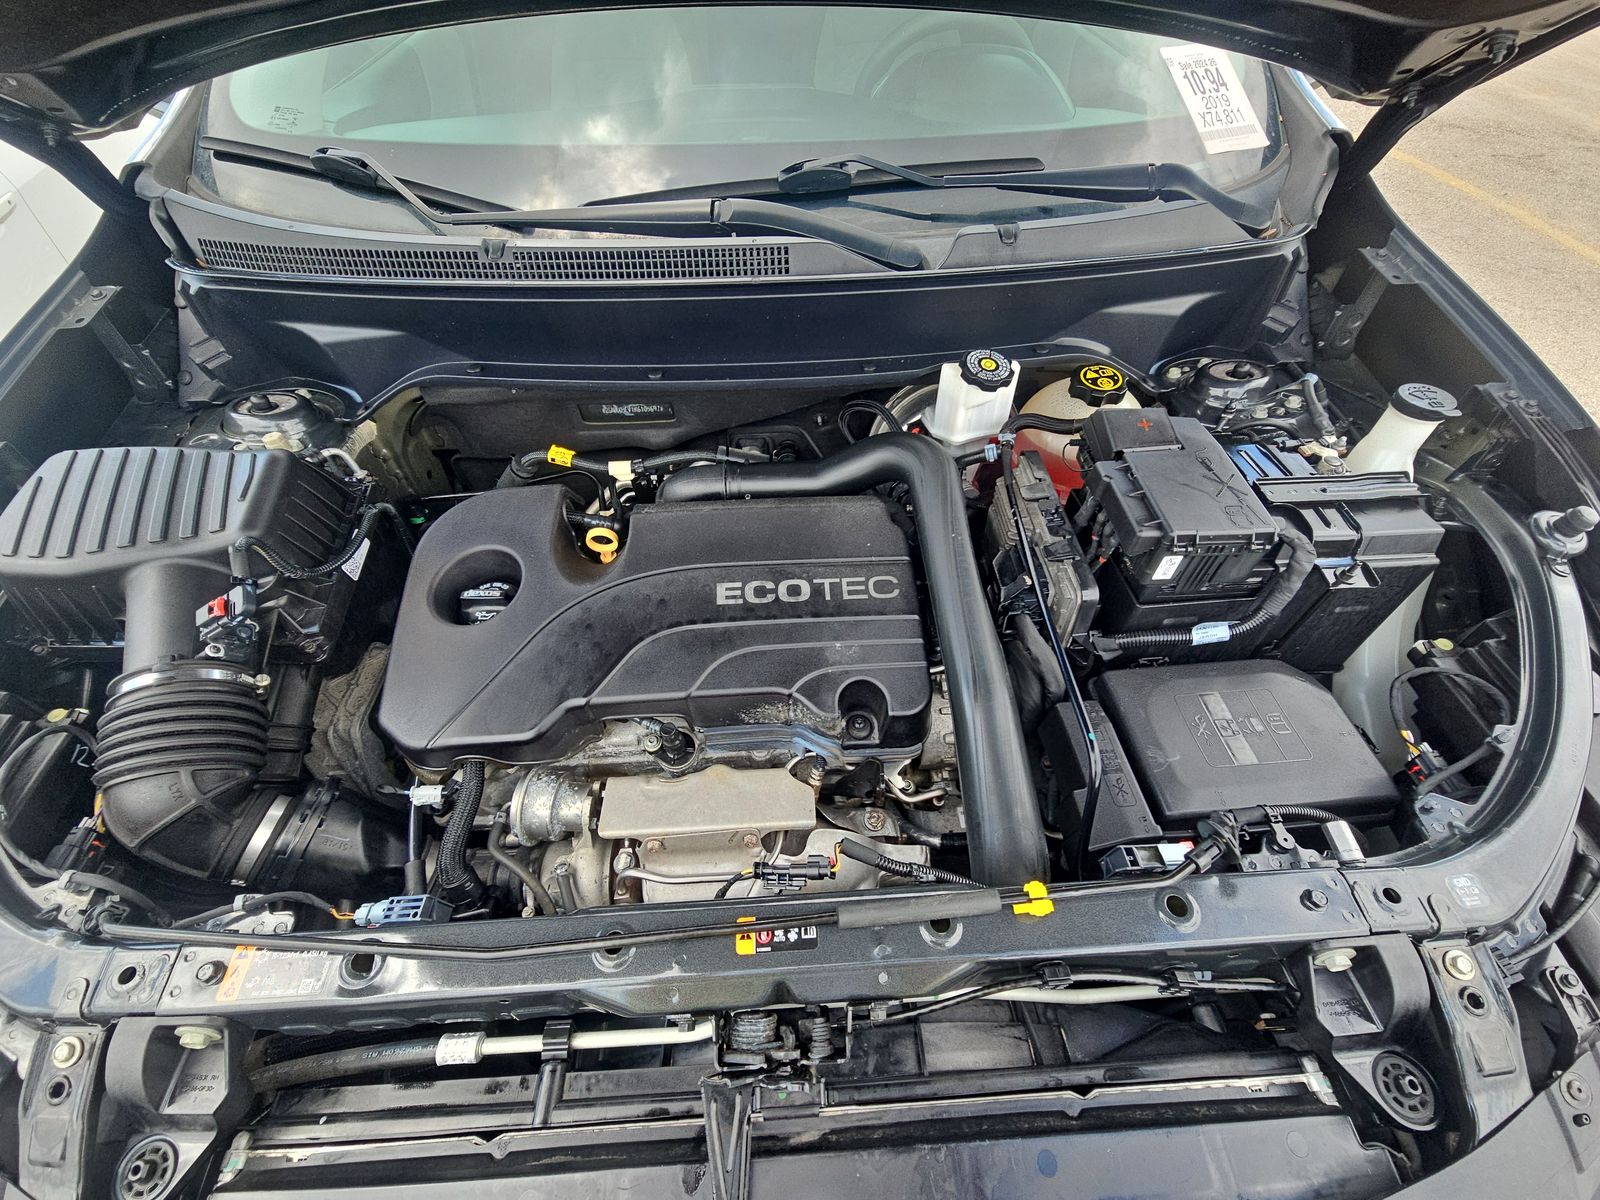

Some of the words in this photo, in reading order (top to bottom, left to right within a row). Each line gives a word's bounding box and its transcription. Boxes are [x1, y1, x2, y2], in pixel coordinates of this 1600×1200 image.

[1183, 67, 1229, 96] 10:94
[1201, 93, 1231, 110] 2019
[1198, 107, 1246, 128] X74,811
[463, 589, 501, 597] dexos
[716, 575, 900, 605] ECOTEC
